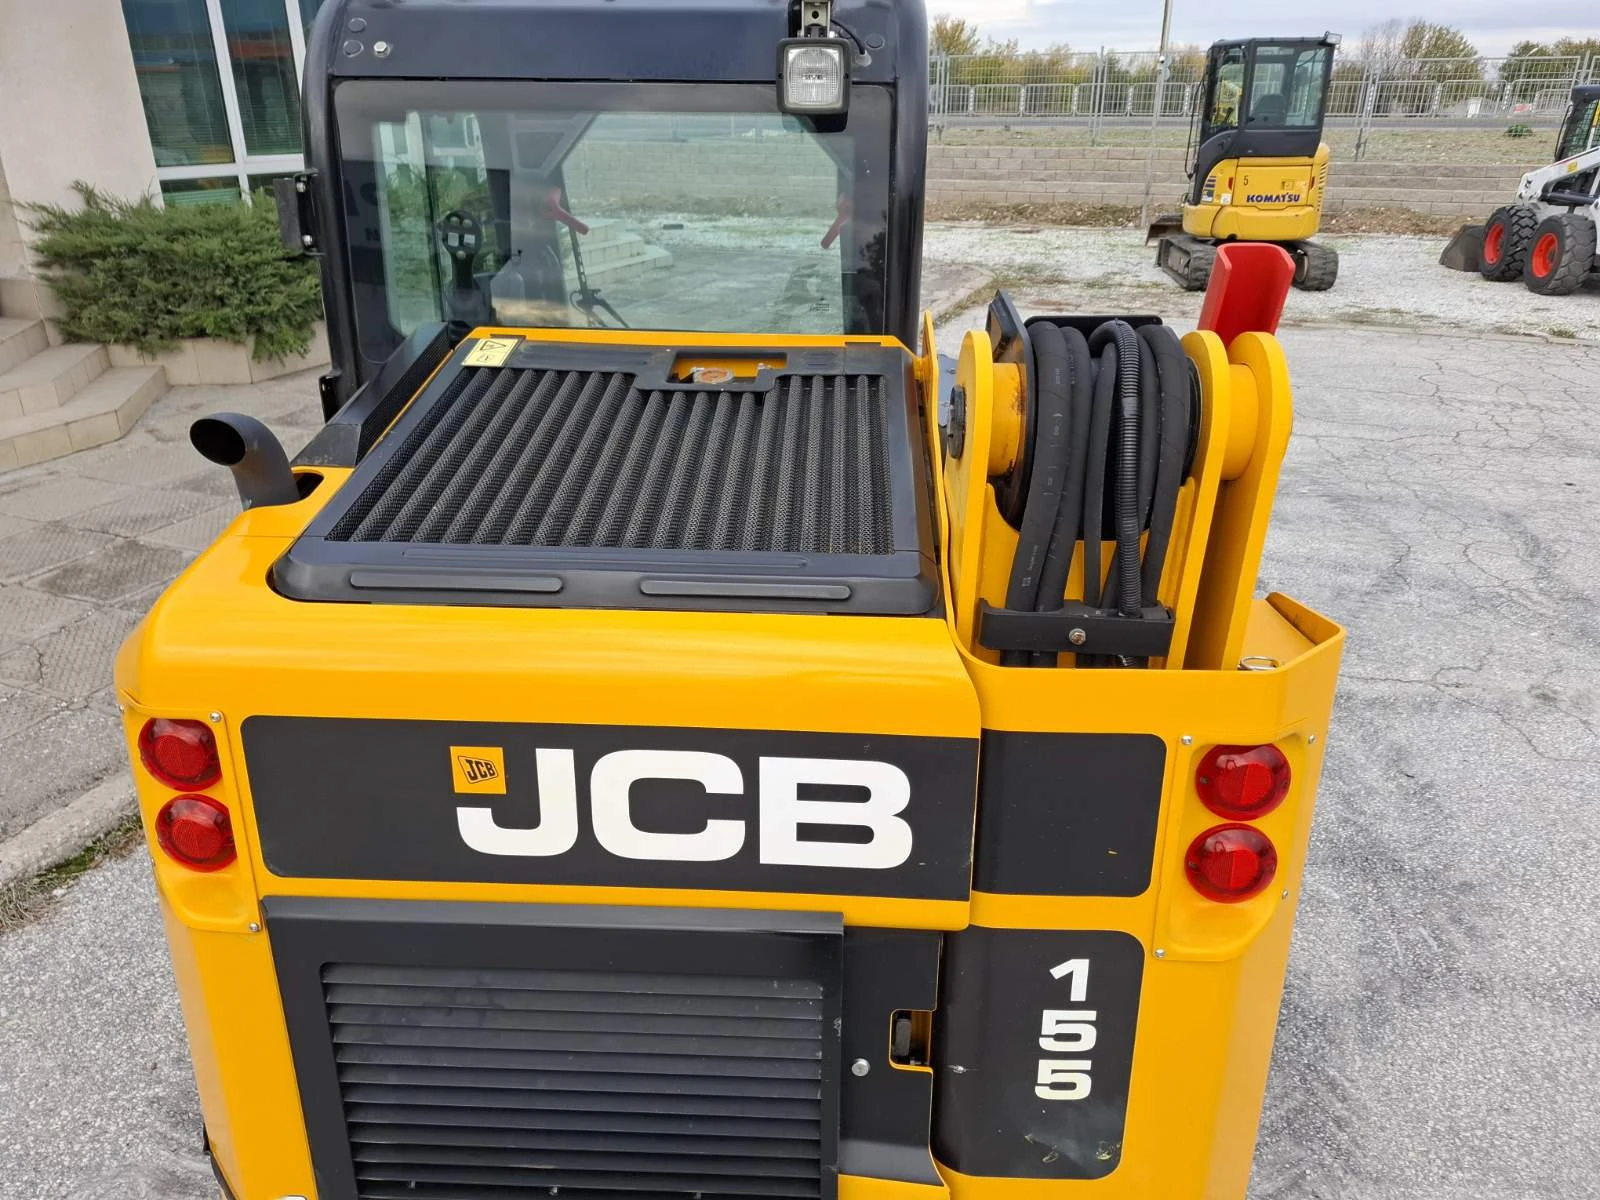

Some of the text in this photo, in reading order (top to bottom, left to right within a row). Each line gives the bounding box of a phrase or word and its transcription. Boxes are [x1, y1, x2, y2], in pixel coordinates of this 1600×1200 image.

[1246, 192, 1301, 203] KOMATSU
[465, 758, 496, 781] JCB
[456, 747, 914, 869] JCB
